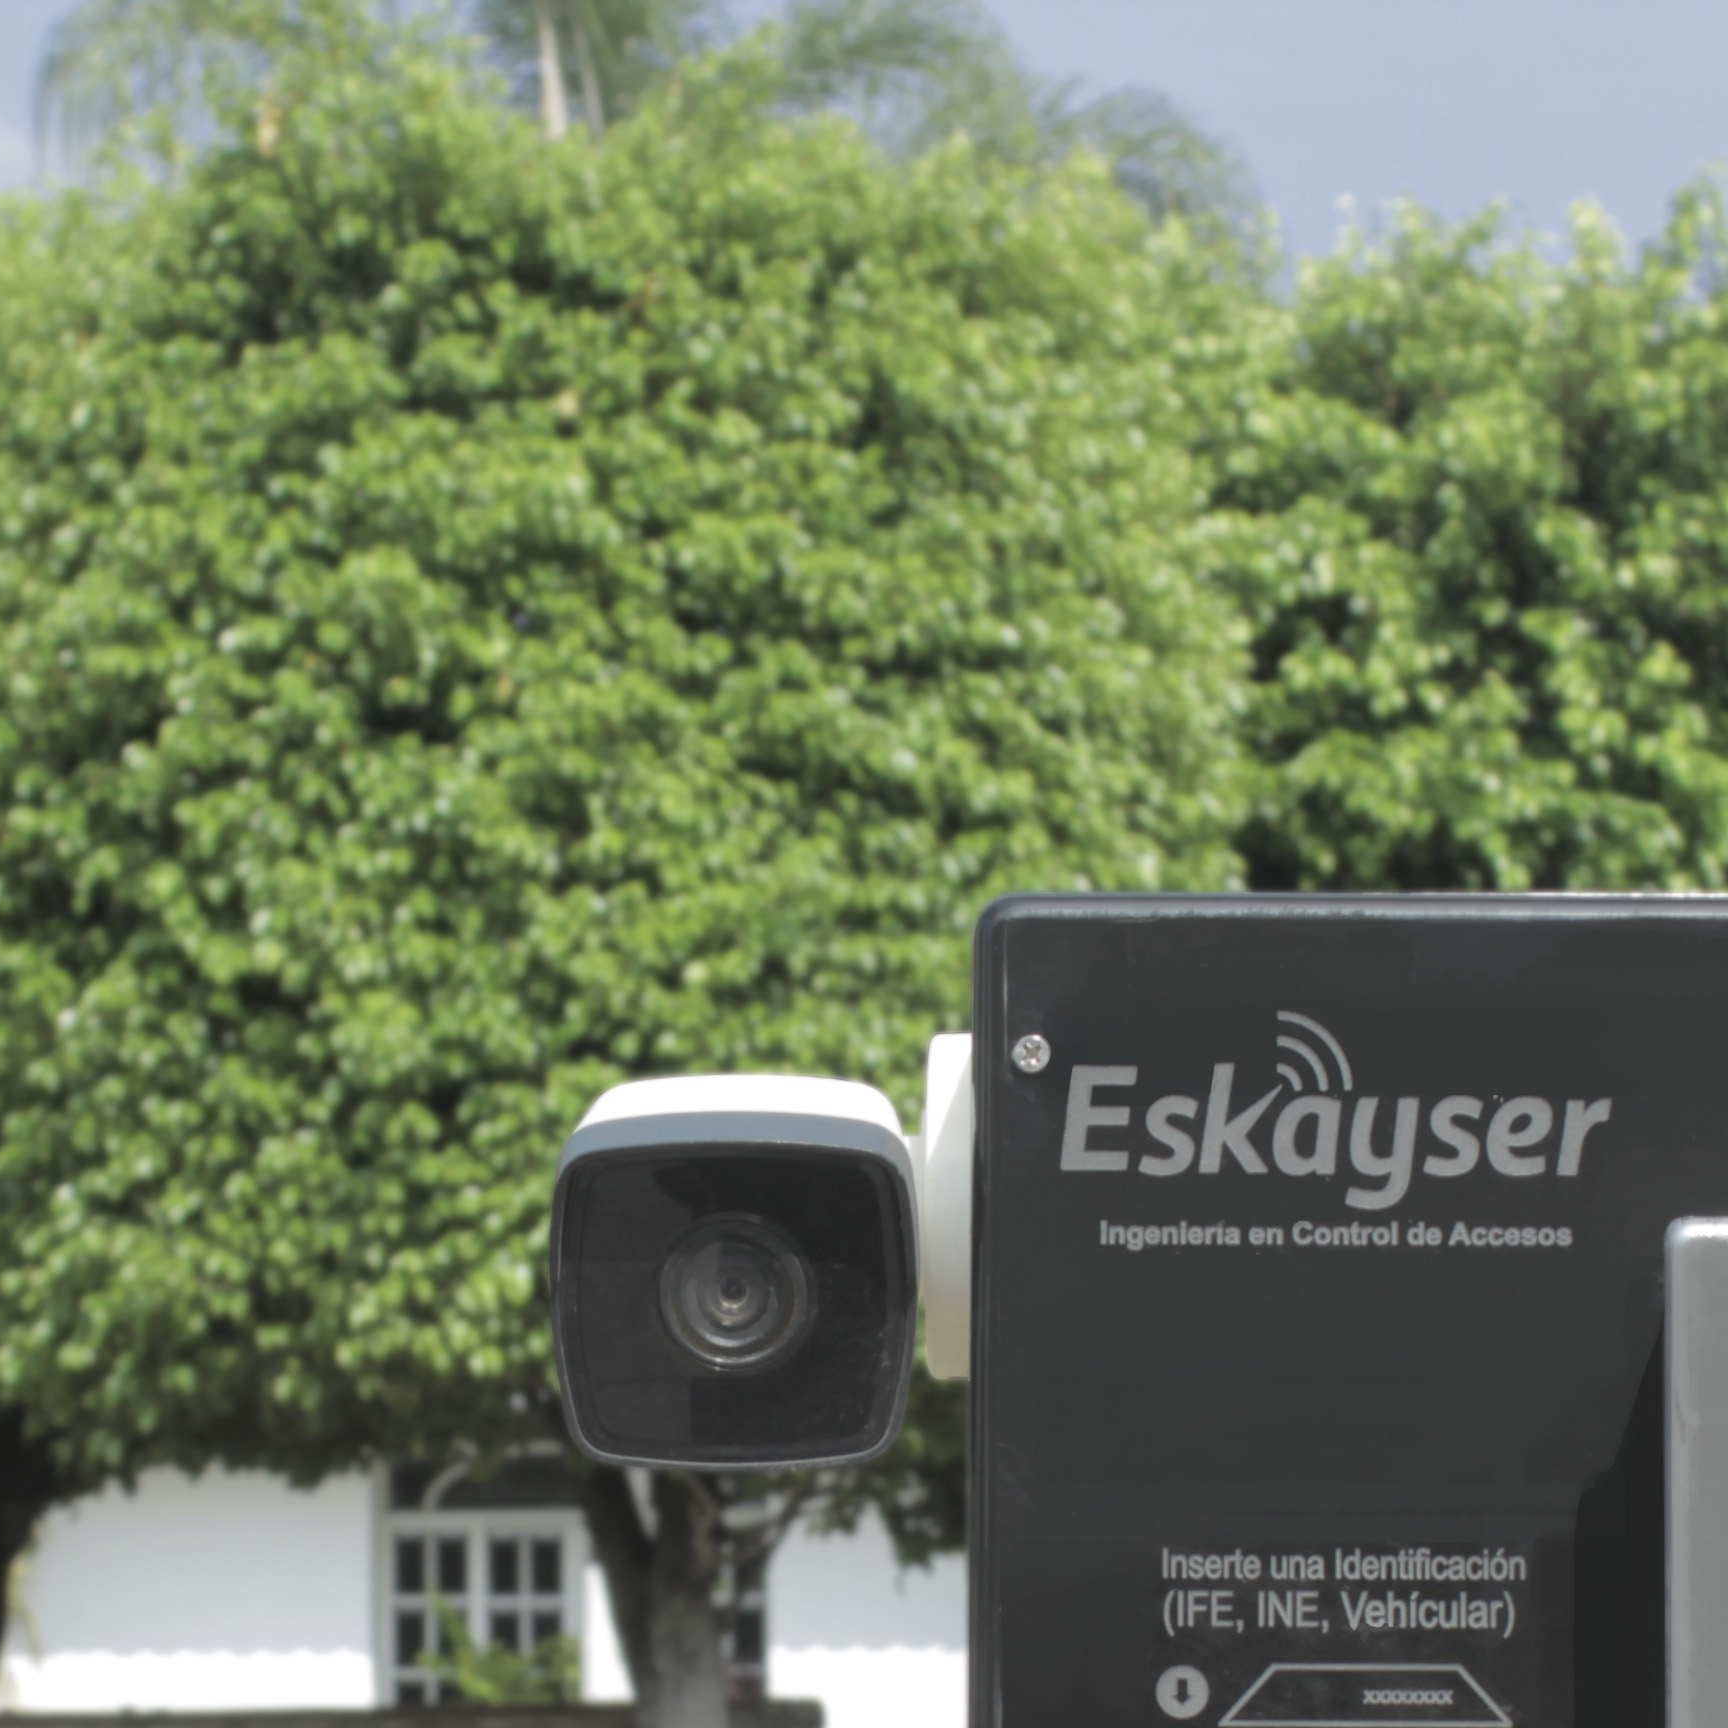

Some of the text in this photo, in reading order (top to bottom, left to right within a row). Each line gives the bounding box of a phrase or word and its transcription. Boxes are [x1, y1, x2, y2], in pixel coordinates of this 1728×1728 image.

[1060, 1062, 1612, 1210] Eskayser
[1099, 1219, 1573, 1250] Ingeniería en Control de Accesos
[1162, 1548, 1526, 1581] Inserte una Identificación
[1163, 1589, 1515, 1638] (IFE, INE, Vehícular)
